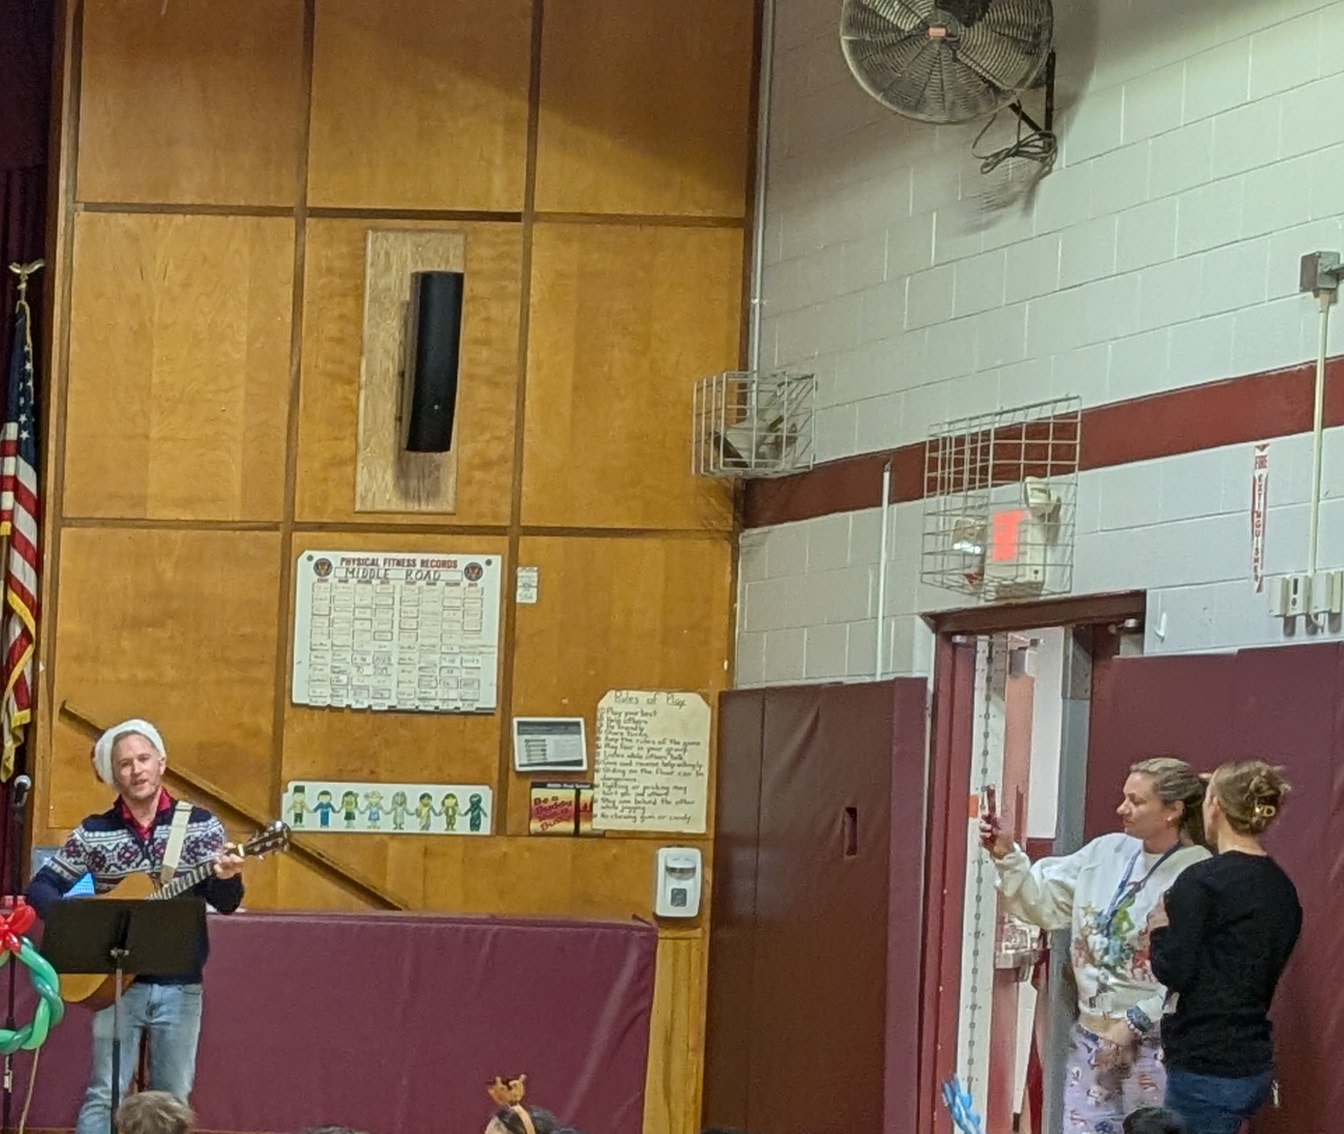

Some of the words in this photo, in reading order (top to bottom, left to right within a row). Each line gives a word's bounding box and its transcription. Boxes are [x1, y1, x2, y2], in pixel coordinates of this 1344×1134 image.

[1253, 474, 1263, 583] EXTINGUISHER
[340, 557, 380, 567] PHYSICAL
[383, 558, 417, 568] FITNESS
[420, 559, 458, 569] RECORDS
[345, 568, 390, 580] MIDDLE
[405, 570, 441, 581] ROAD
[614, 690, 639, 704] Rules
[647, 692, 658, 704] of
[666, 693, 686, 709] Play
